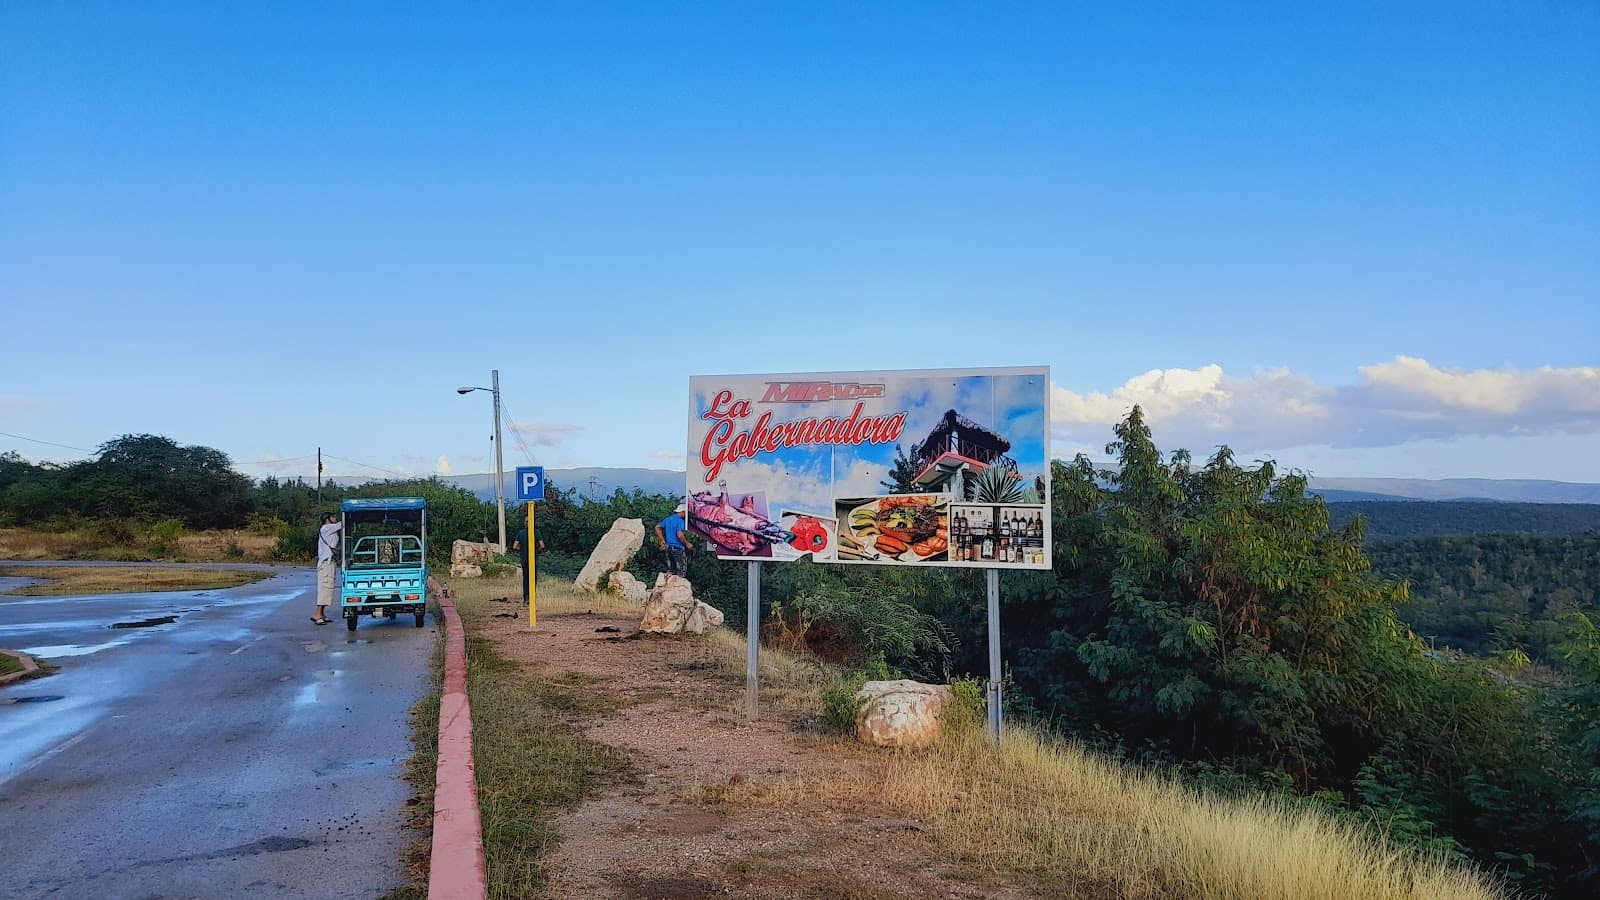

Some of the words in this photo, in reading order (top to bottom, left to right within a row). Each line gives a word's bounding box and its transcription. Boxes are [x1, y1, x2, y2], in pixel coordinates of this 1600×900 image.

[702, 389, 751, 419] La
[701, 400, 907, 484] Gobernadora
[523, 472, 538, 495] P
